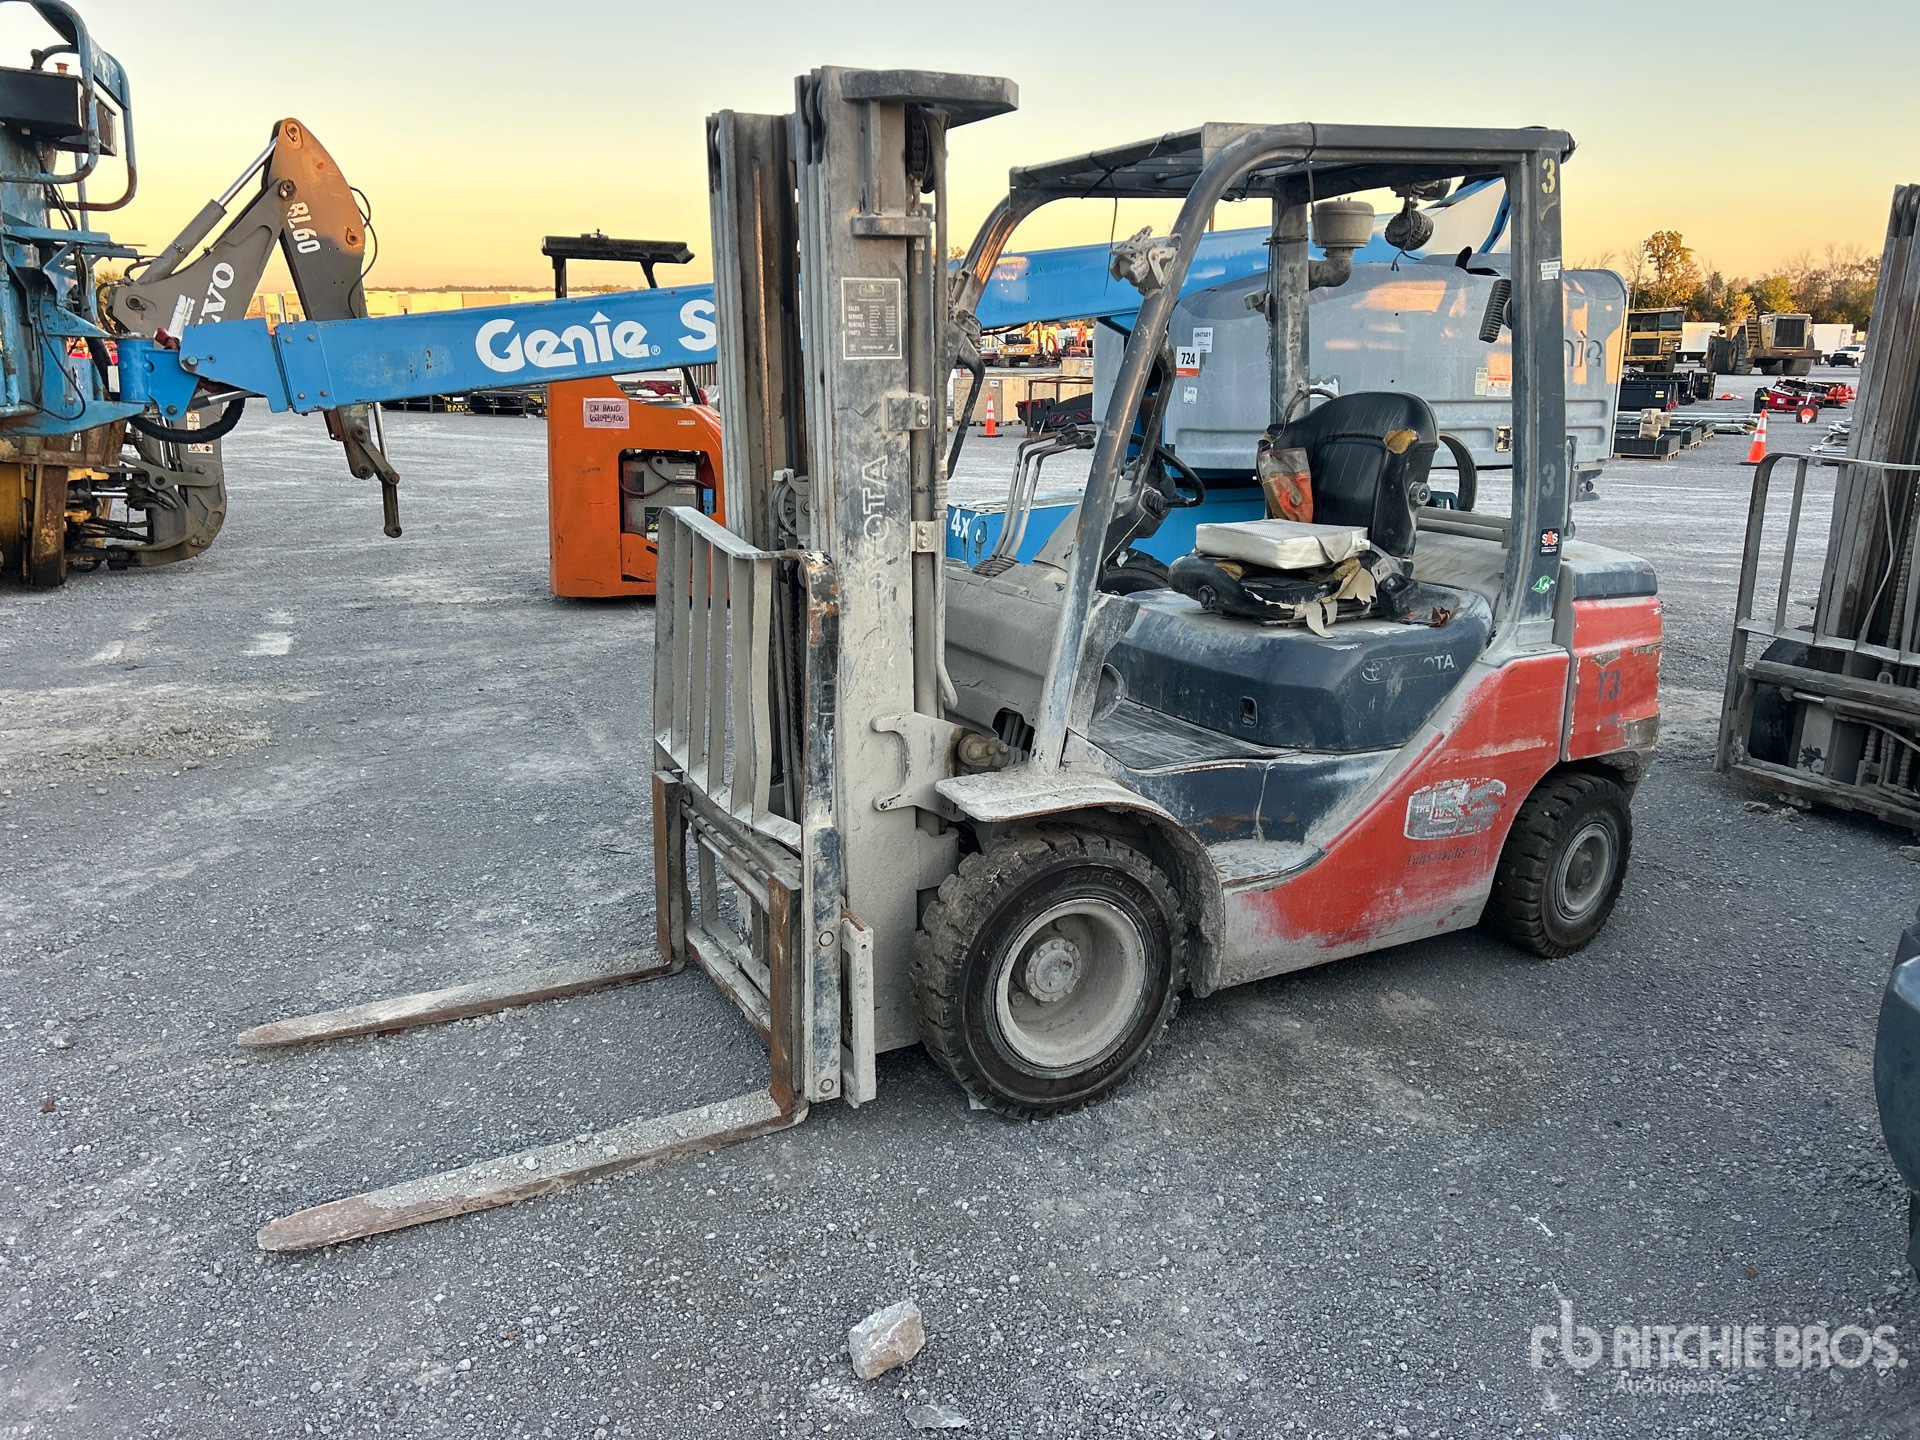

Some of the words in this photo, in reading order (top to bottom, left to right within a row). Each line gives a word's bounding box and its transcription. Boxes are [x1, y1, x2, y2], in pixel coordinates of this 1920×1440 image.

[1541, 158, 1556, 194] 3
[475, 311, 650, 373] Genie
[1181, 353, 1195, 365] 724
[602, 404, 621, 412] HAND
[1541, 463, 1556, 498] 3
[950, 508, 971, 540] 4x
[1541, 530, 1559, 546] SAS
